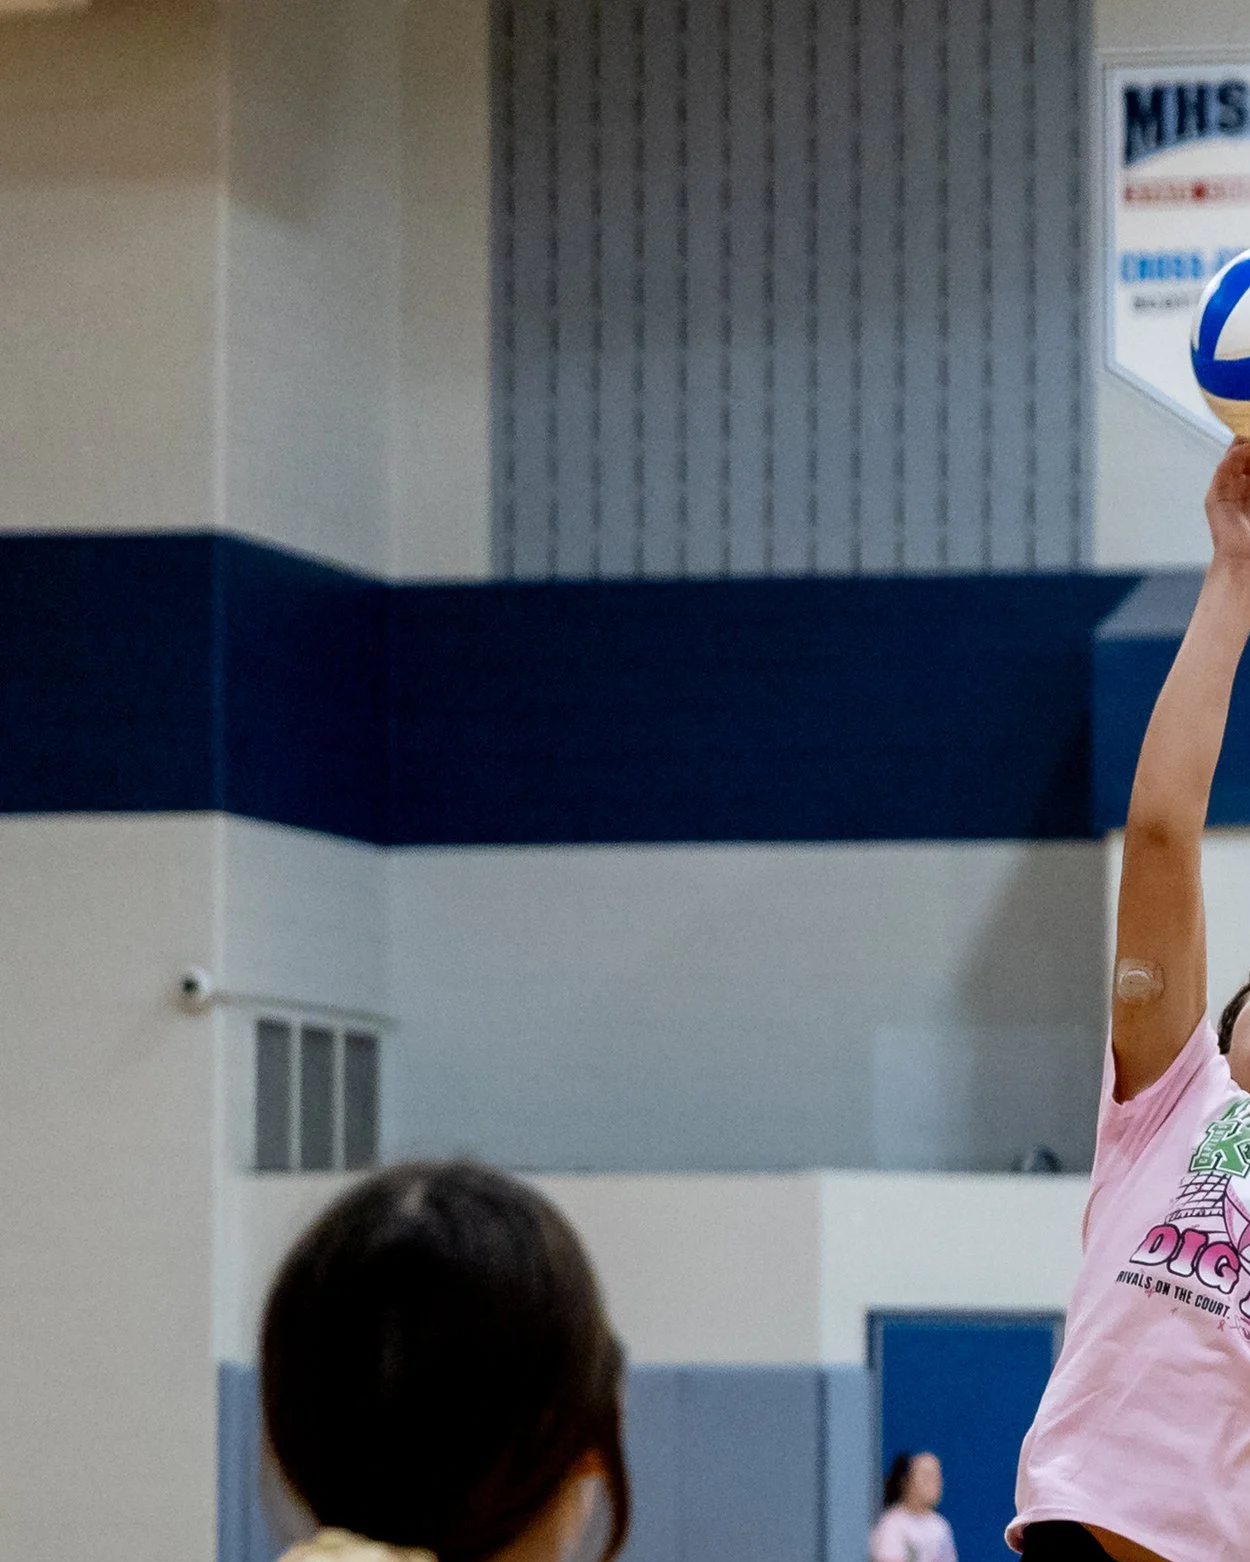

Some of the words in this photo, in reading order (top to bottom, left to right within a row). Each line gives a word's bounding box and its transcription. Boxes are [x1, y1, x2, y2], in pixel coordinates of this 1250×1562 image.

[1130, 1223, 1240, 1295] DIG
[1116, 1270, 1153, 1289] RIVALS
[1155, 1280, 1171, 1296] ON
[1174, 1285, 1193, 1304] THE
[1194, 1294, 1231, 1319] COURT.
